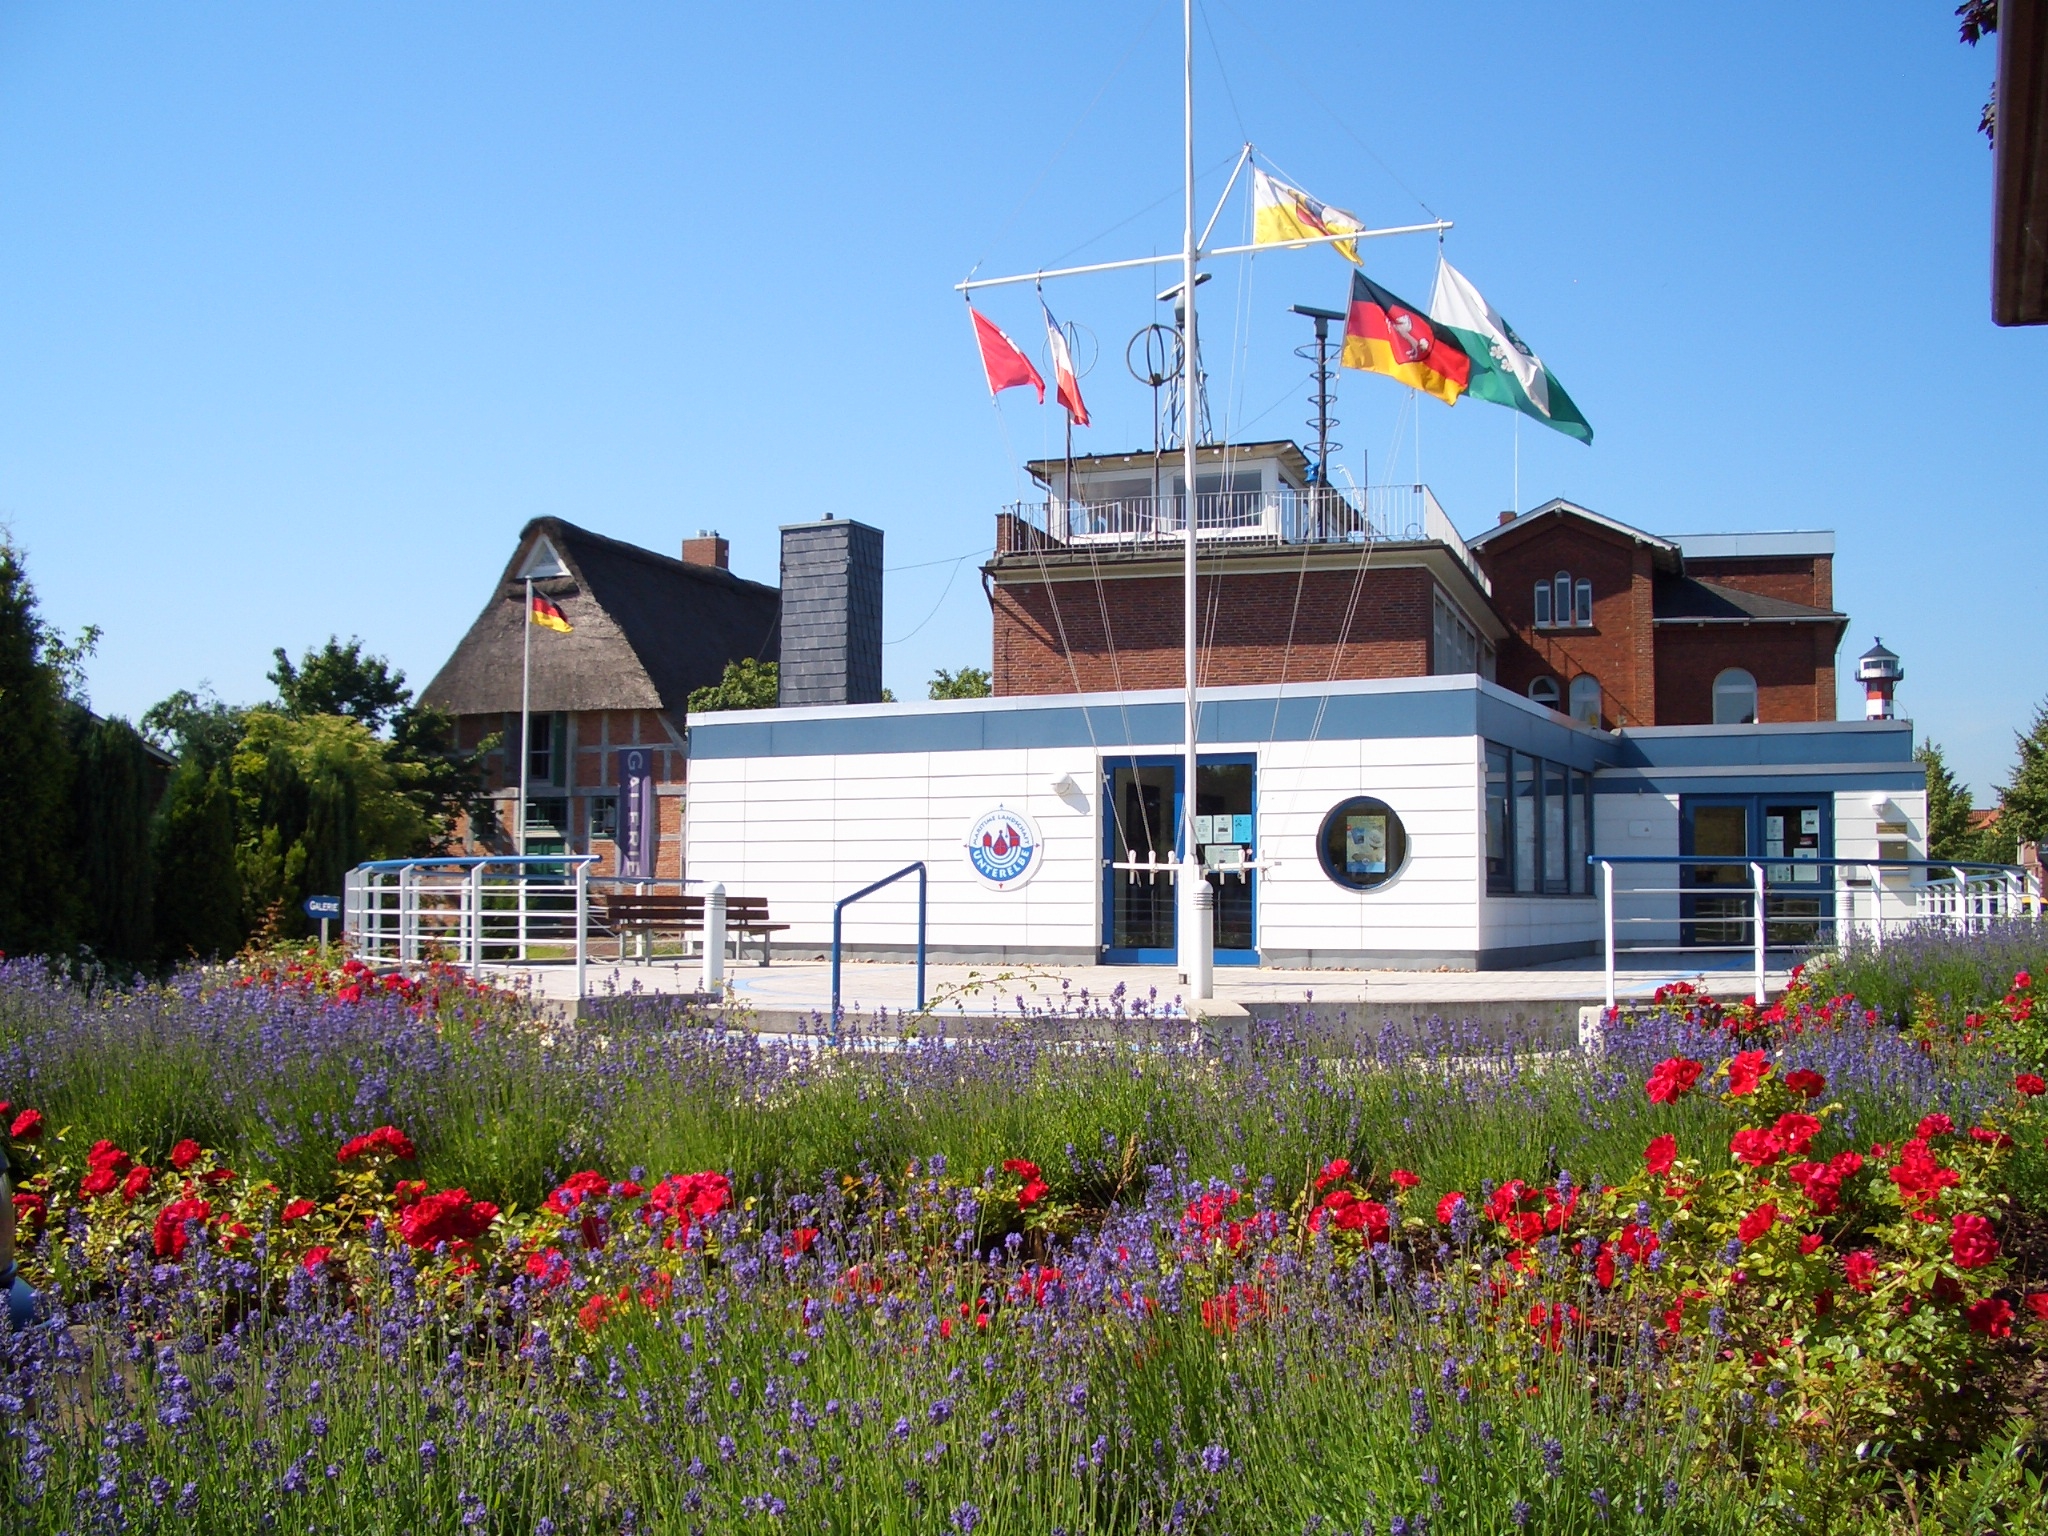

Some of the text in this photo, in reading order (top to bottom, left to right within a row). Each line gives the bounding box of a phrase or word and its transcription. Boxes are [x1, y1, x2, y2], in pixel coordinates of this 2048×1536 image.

[973, 815, 1029, 845] MARITIME LANDSCHAFT
[973, 850, 1029, 877] UNTERELBE
